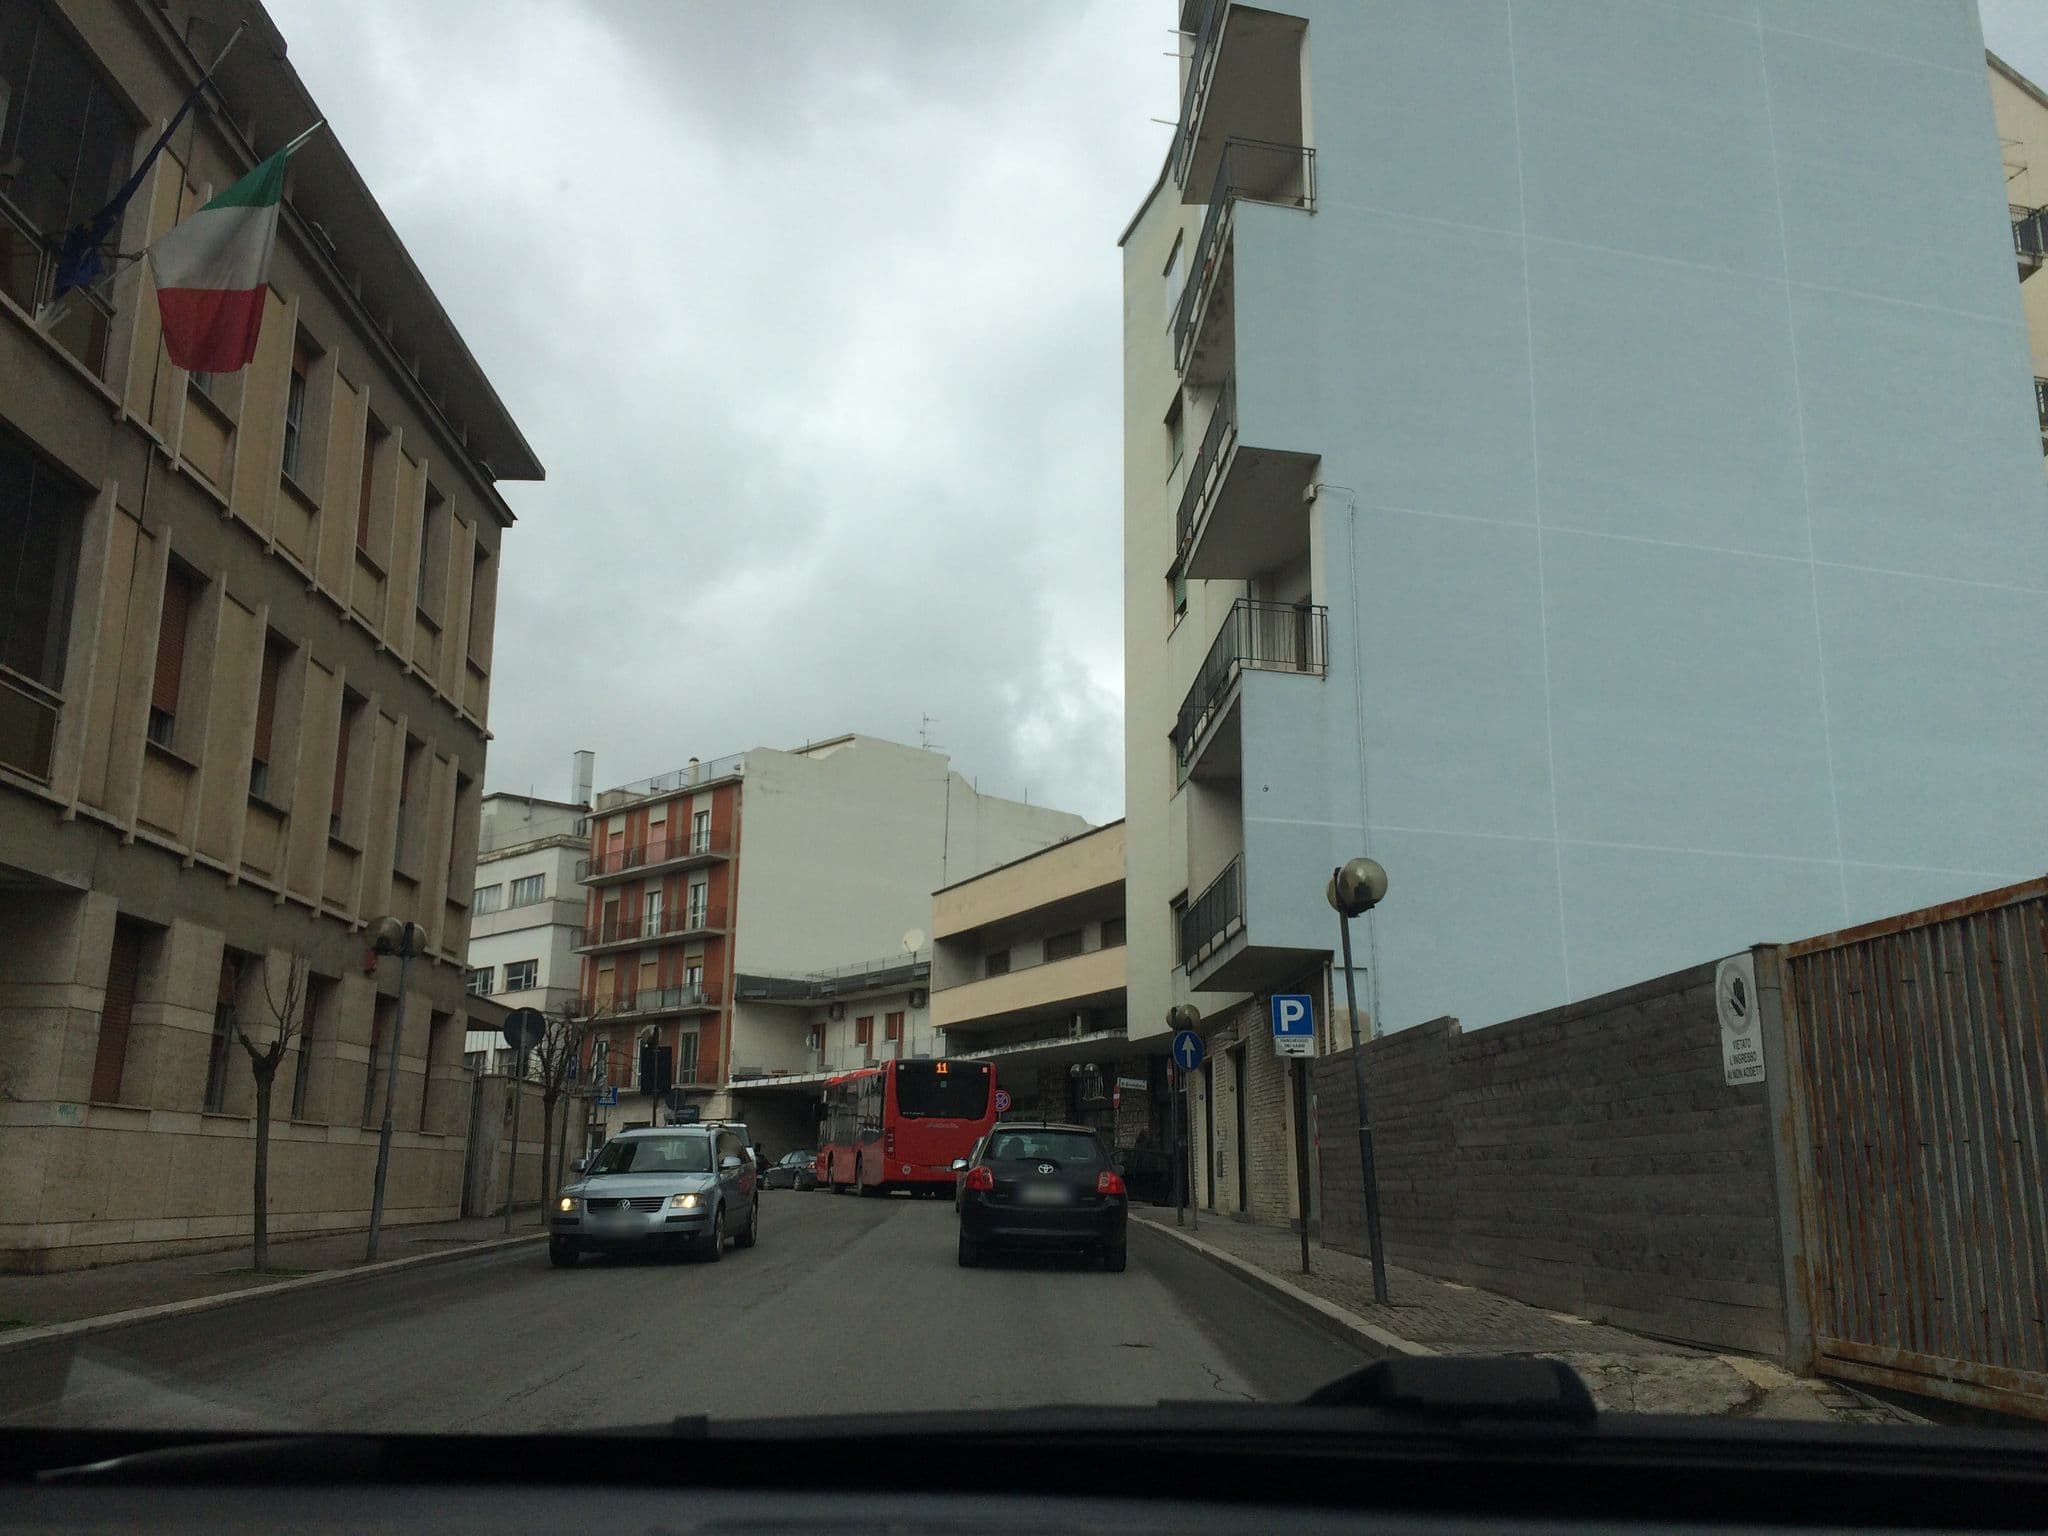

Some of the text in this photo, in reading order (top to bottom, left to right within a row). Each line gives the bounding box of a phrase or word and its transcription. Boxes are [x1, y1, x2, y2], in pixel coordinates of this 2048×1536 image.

[1280, 1000, 1304, 1032] P
[1732, 1038, 1751, 1050] VIETATO
[936, 1062, 948, 1074] 11
